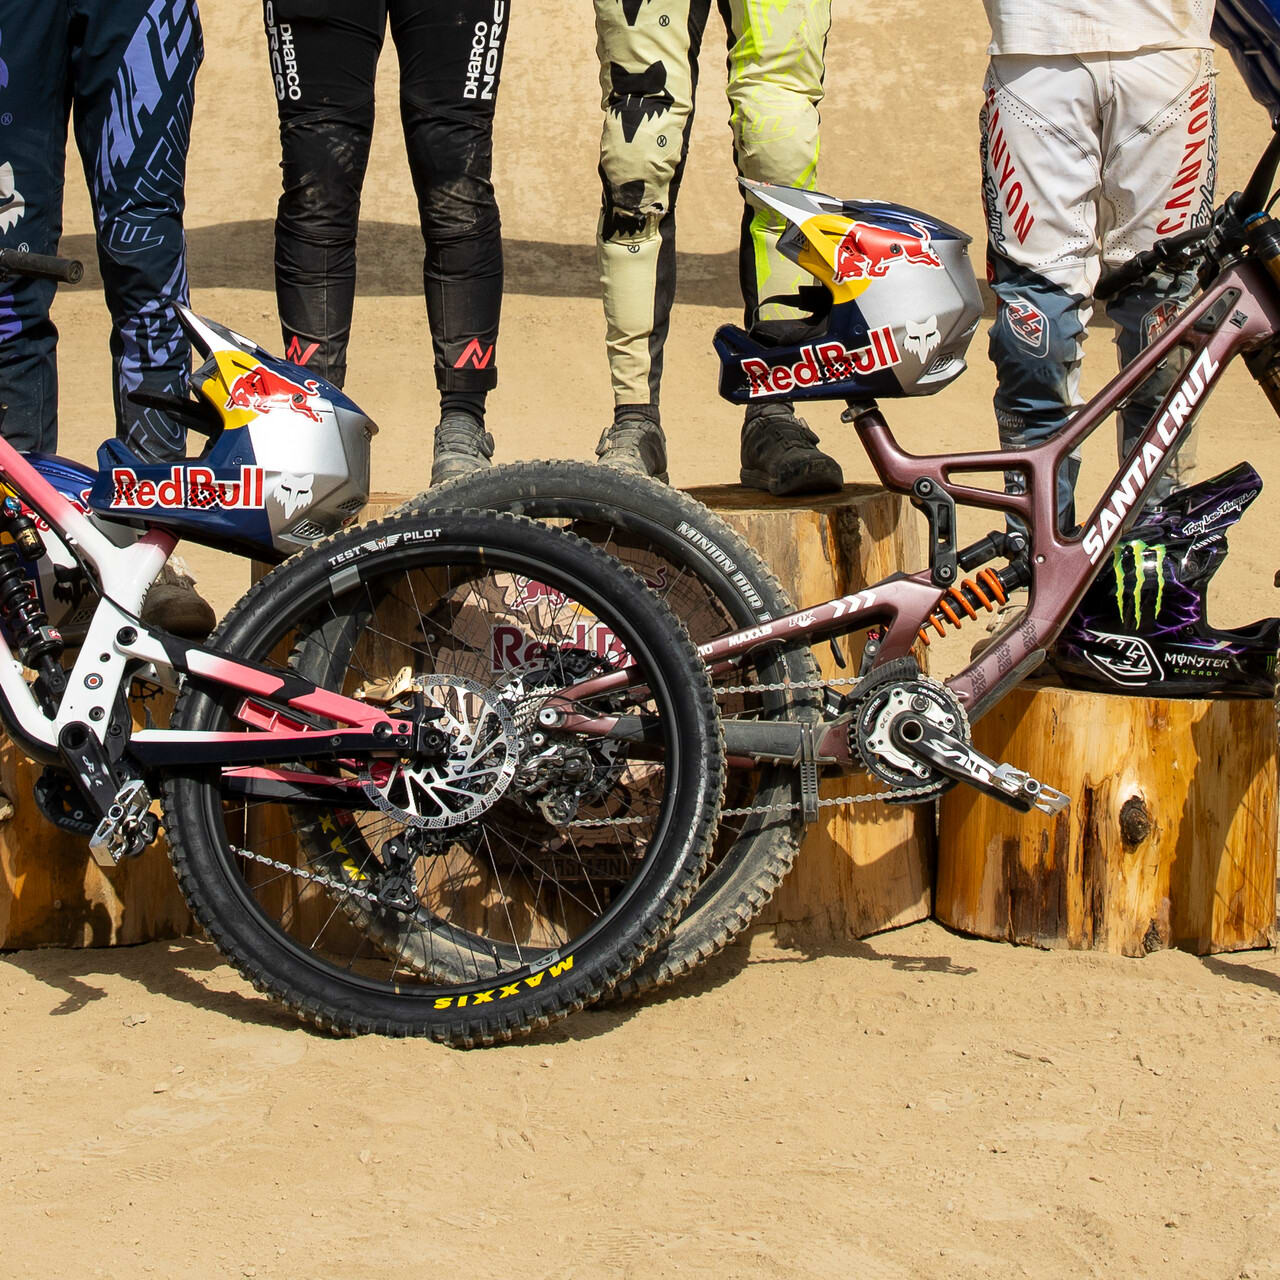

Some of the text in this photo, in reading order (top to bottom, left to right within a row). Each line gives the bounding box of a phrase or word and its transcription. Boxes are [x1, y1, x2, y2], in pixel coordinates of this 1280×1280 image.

[1156, 82, 1210, 235] CANYON
[740, 325, 901, 397] Red Bull
[1082, 348, 1220, 565] SANTA CRUZ
[111, 467, 265, 511] Red Bull
[328, 528, 442, 566] TEST PILOT
[676, 521, 764, 610] MINION DHR
[1192, 534, 1222, 551] CANYON
[728, 626, 773, 647] MAXXIS
[1174, 669, 1220, 677] ENERGY
[433, 955, 574, 1010] MAXXIS
